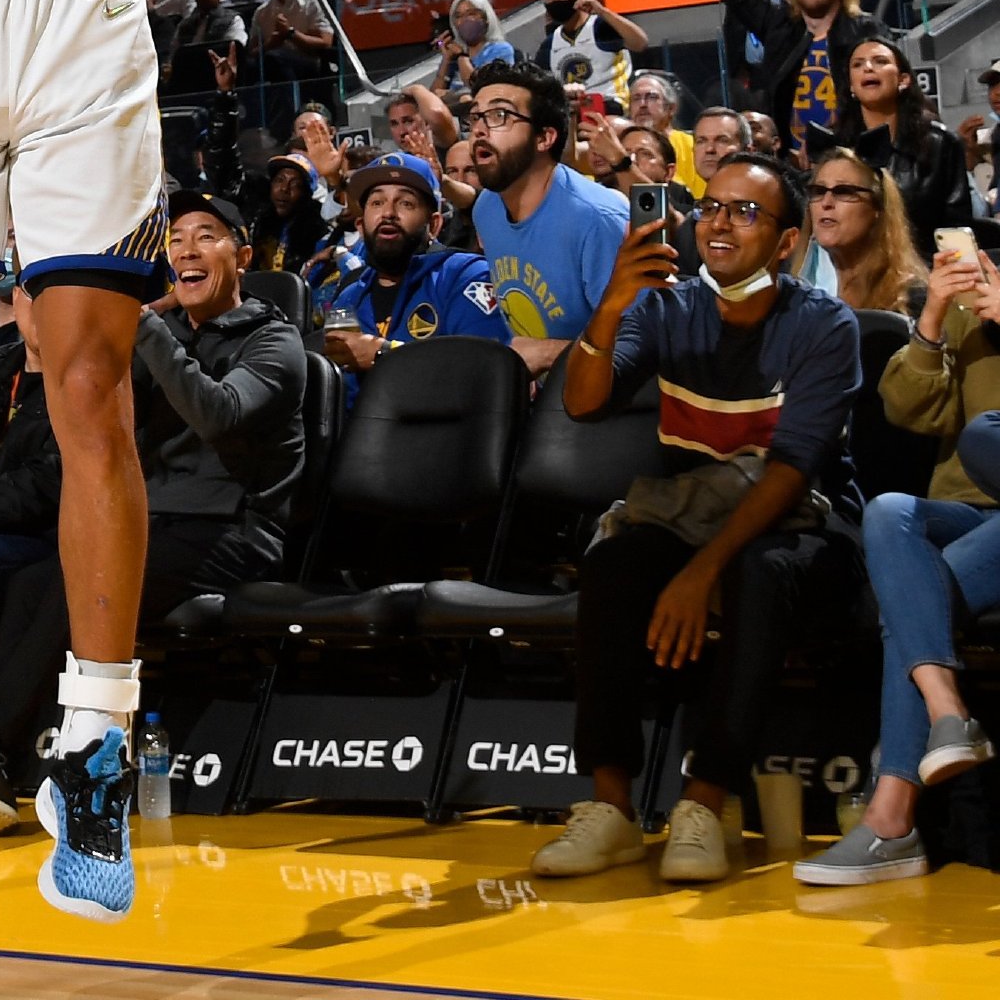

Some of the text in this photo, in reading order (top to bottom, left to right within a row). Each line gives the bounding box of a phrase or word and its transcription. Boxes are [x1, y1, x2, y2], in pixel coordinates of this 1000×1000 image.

[793, 75, 838, 110] 24
[524, 263, 564, 320] STATE
[272, 739, 389, 768] CHASE
